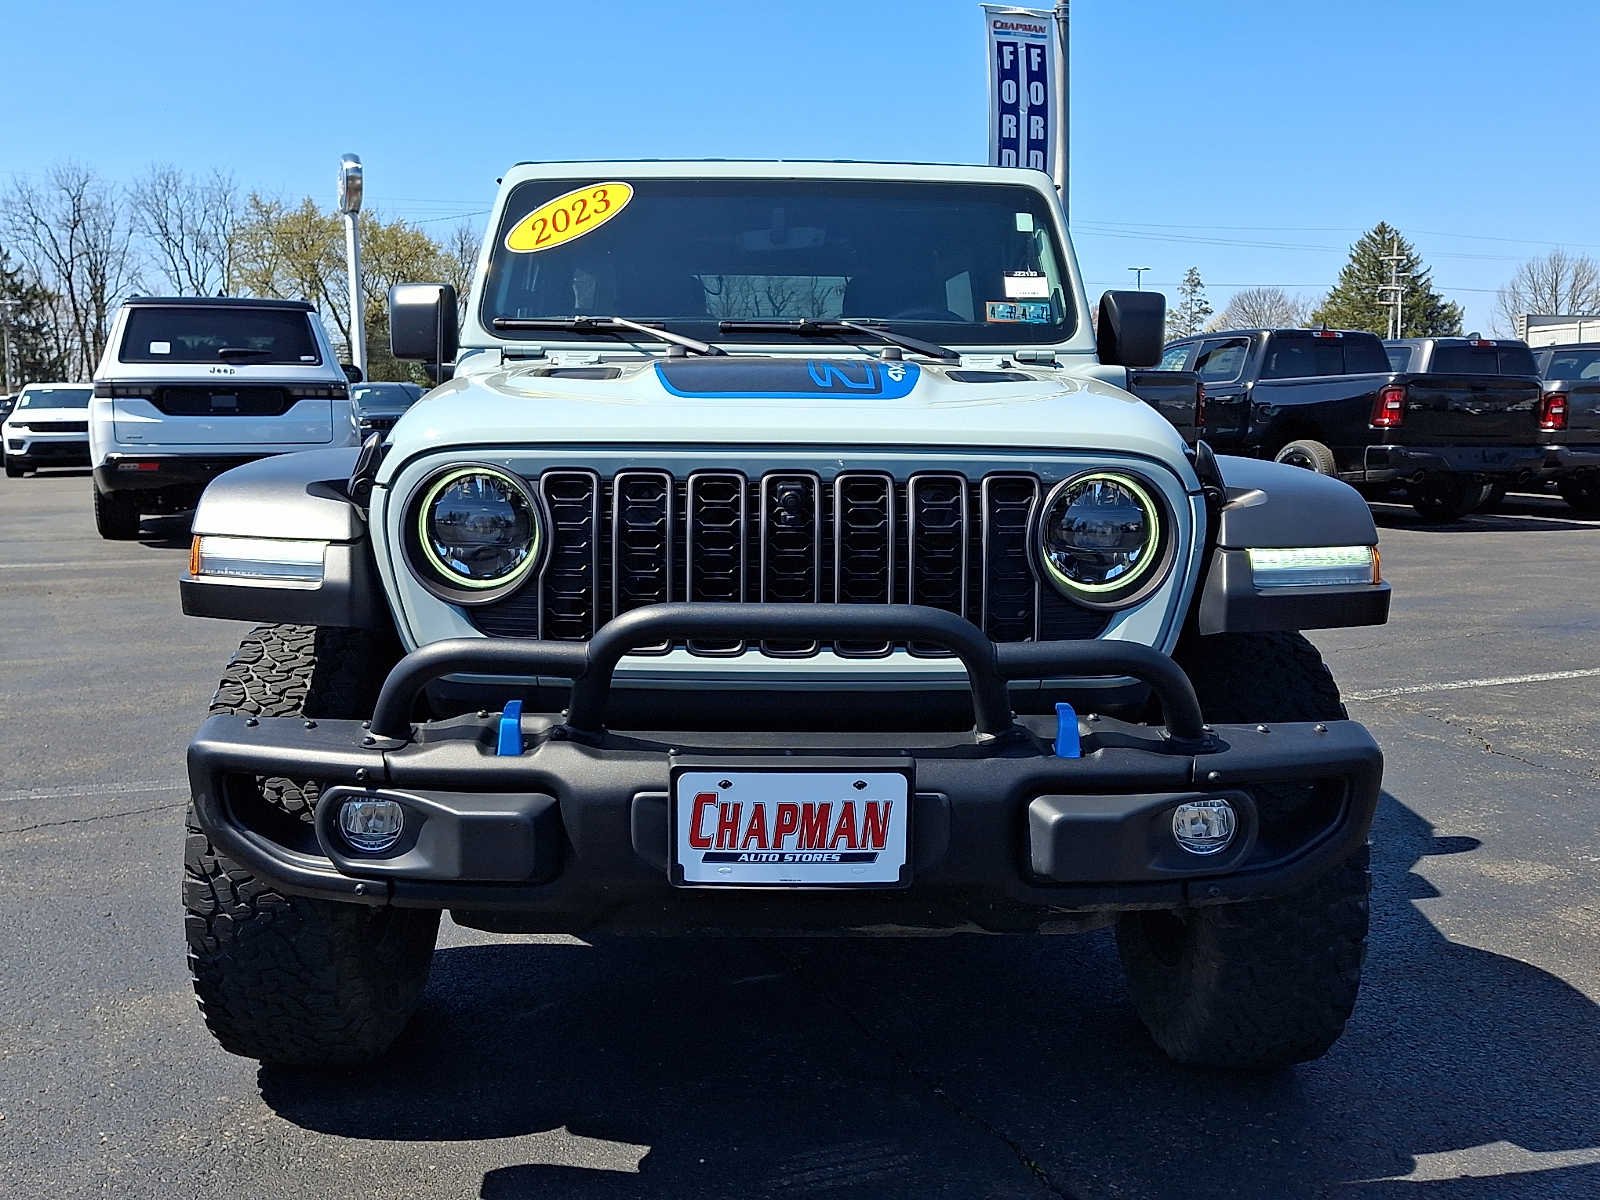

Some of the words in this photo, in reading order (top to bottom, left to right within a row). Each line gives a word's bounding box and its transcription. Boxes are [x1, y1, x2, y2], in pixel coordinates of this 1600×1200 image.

[993, 20, 1046, 33] CHAPMAN
[531, 189, 611, 245] 2023
[209, 367, 235, 375] Jeep
[688, 792, 893, 850] CHAPMAN
[737, 853, 780, 862] AUTO
[783, 853, 841, 862] STORES
